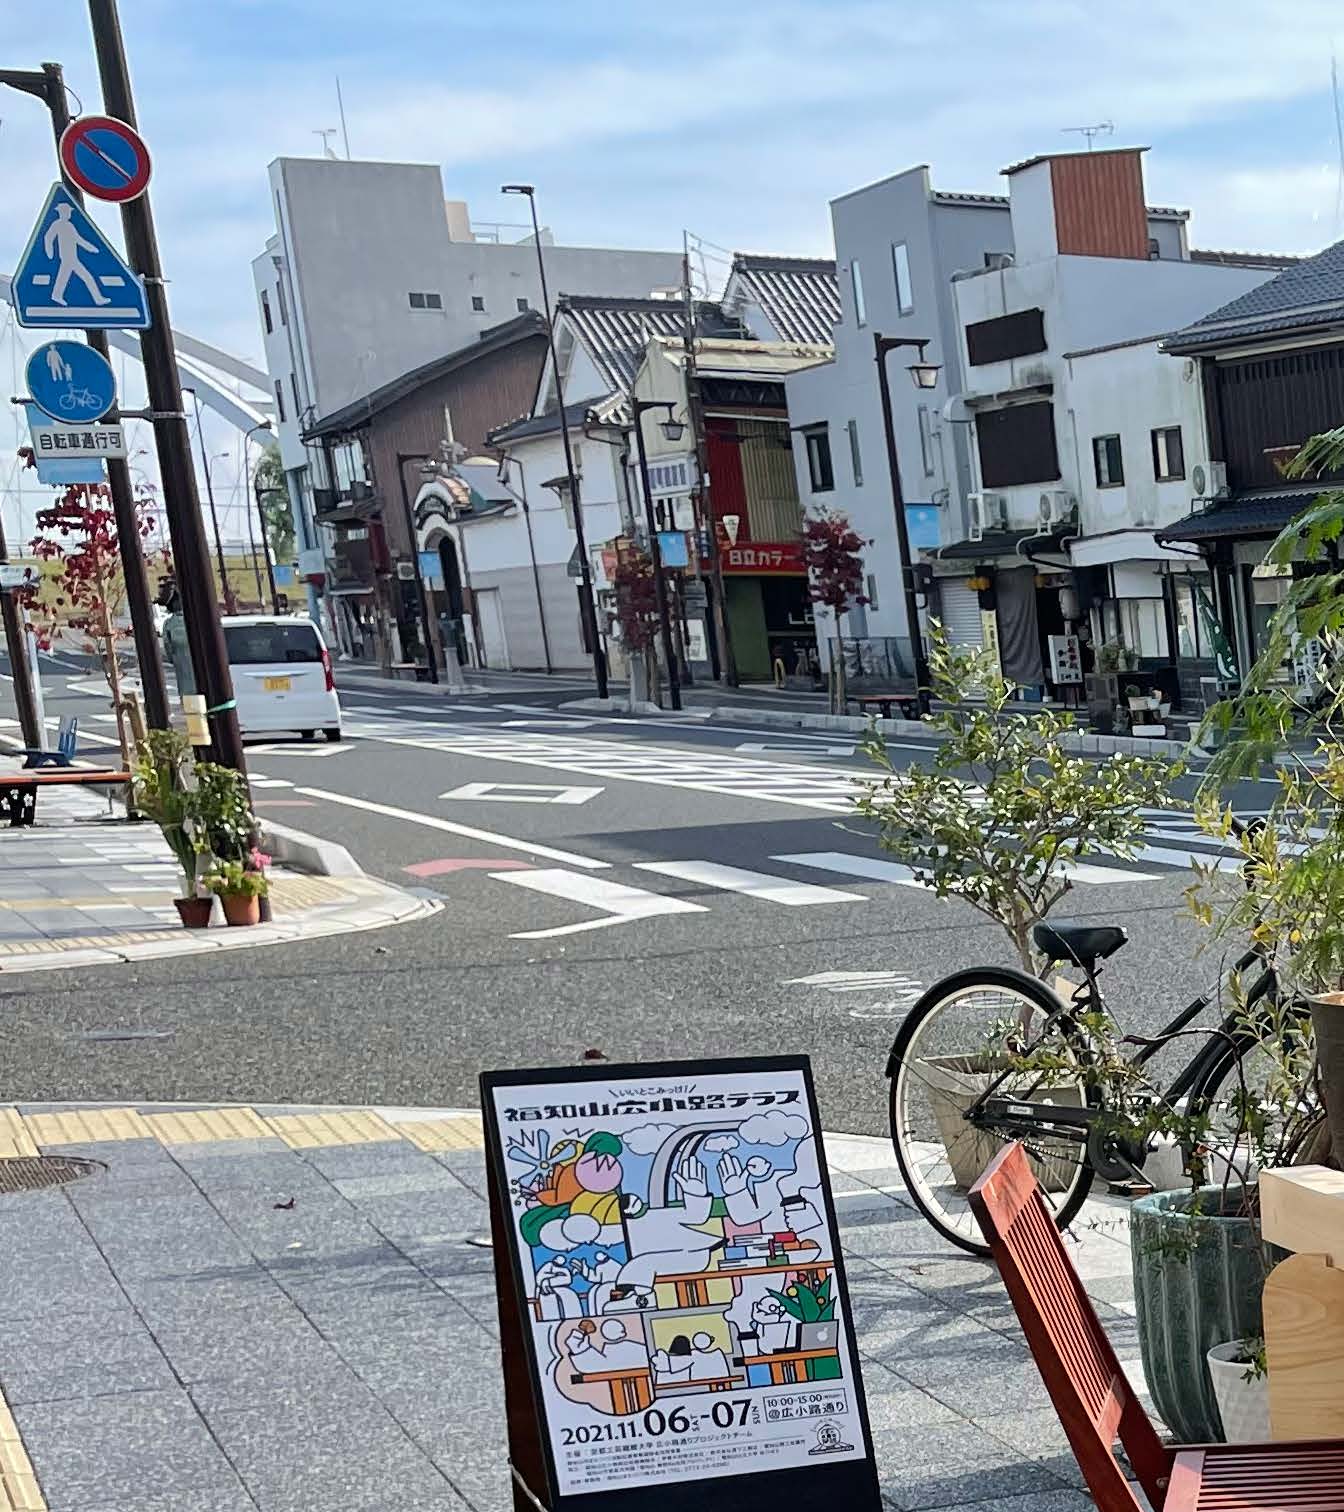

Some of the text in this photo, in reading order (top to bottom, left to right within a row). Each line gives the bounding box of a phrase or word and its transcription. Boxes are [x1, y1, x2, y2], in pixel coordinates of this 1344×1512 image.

[40, 432, 121, 450] 自転車通行可
[729, 549, 797, 566] 日立カラー
[503, 1089, 801, 1122] 福知山広小路テラス
[768, 1401, 844, 1419] @広小路通り
